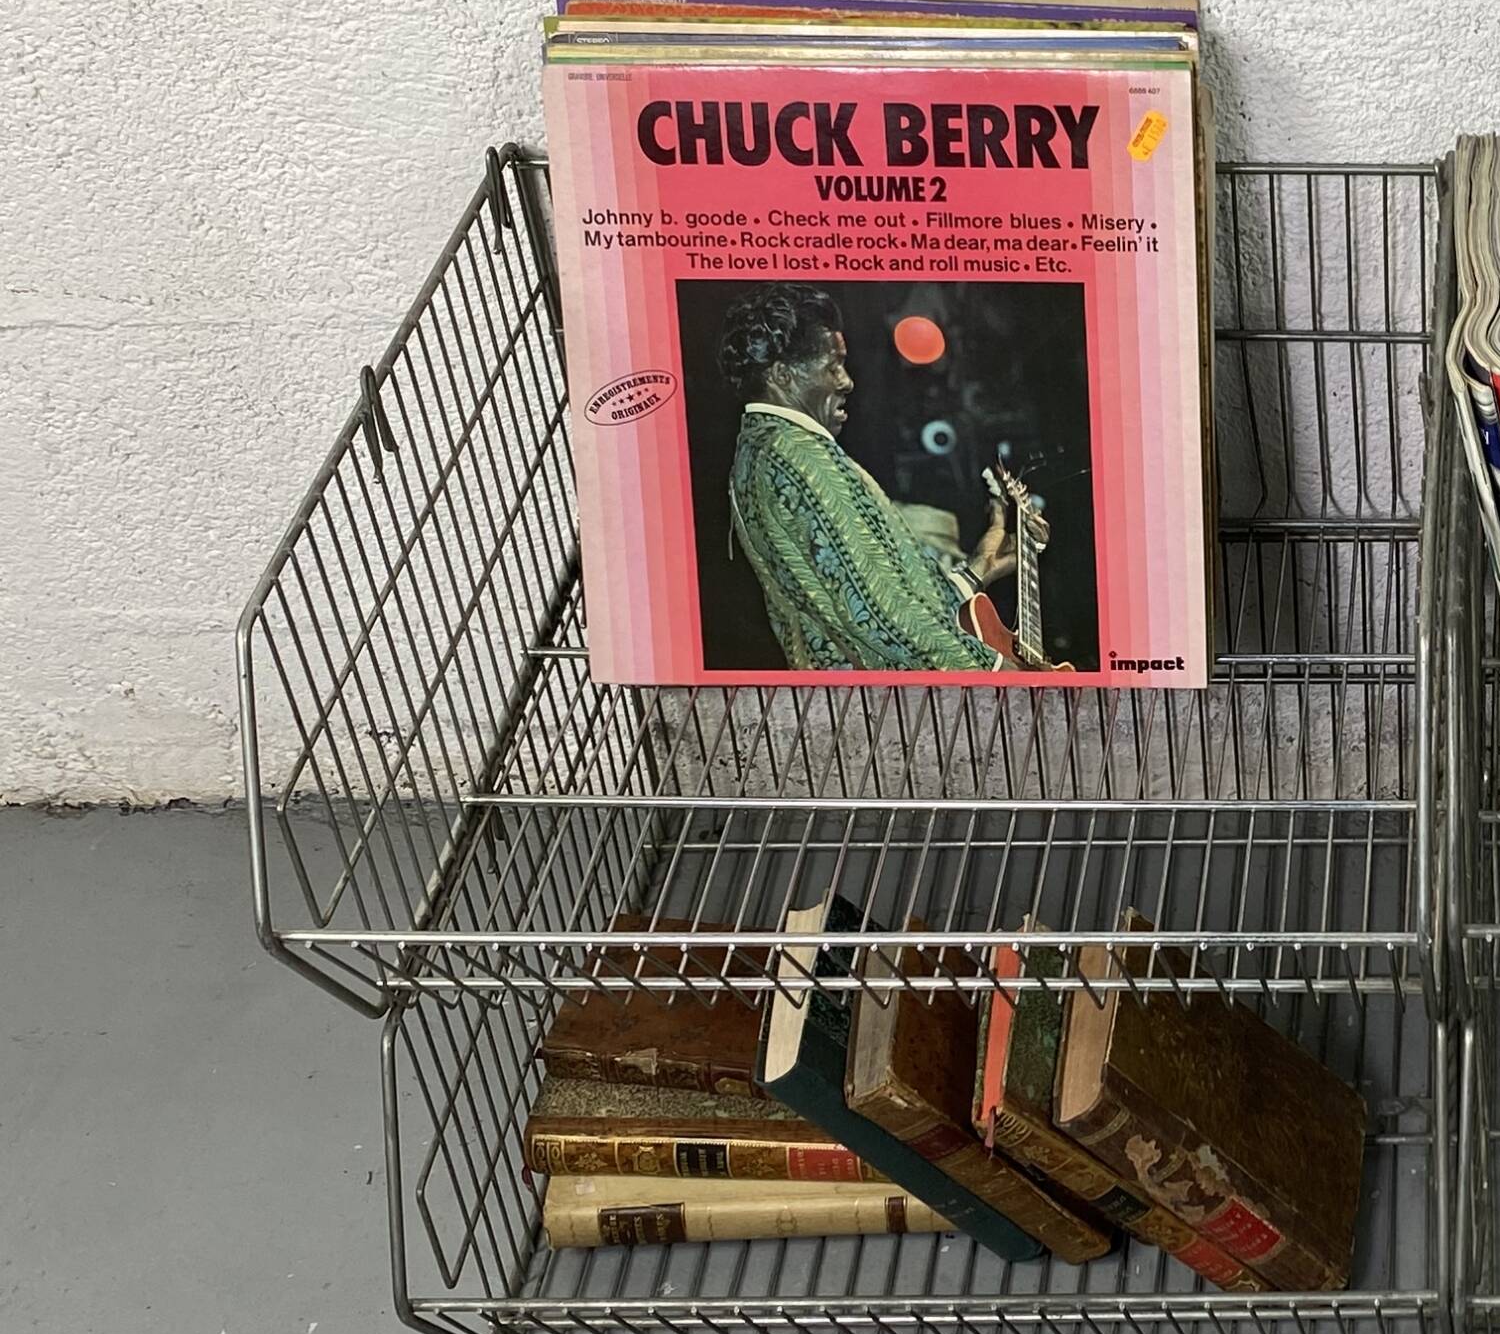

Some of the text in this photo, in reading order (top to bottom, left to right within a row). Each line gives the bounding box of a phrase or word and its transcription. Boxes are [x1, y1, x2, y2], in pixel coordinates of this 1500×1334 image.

[637, 100, 864, 167] CHUCK
[883, 102, 1100, 169] BERRY
[814, 175, 947, 202] VOLUME 2
[582, 208, 1145, 233] Johnny b. goode Check me out Fillmore blues Misery
[584, 230, 613, 250] My
[617, 231, 727, 248] tambourine
[740, 231, 790, 248] Rock
[793, 233, 853, 249] cradle
[857, 233, 898, 250] rock
[911, 233, 940, 250] Ma
[944, 234, 991, 253] dear,
[994, 238, 1022, 251] ma
[1026, 235, 1069, 252] dear
[1146, 236, 1159, 253] it
[686, 253, 723, 269] The
[728, 254, 768, 269] love
[783, 254, 819, 270] lost
[835, 254, 884, 271] Rock
[889, 256, 924, 271] and
[929, 256, 958, 271] roll
[964, 256, 1020, 273] music
[1035, 256, 1072, 273] Etc.
[589, 374, 671, 414] ENREGISTREMENTS
[611, 393, 661, 420] ORIGINAUX
[1110, 651, 1185, 674] impact
